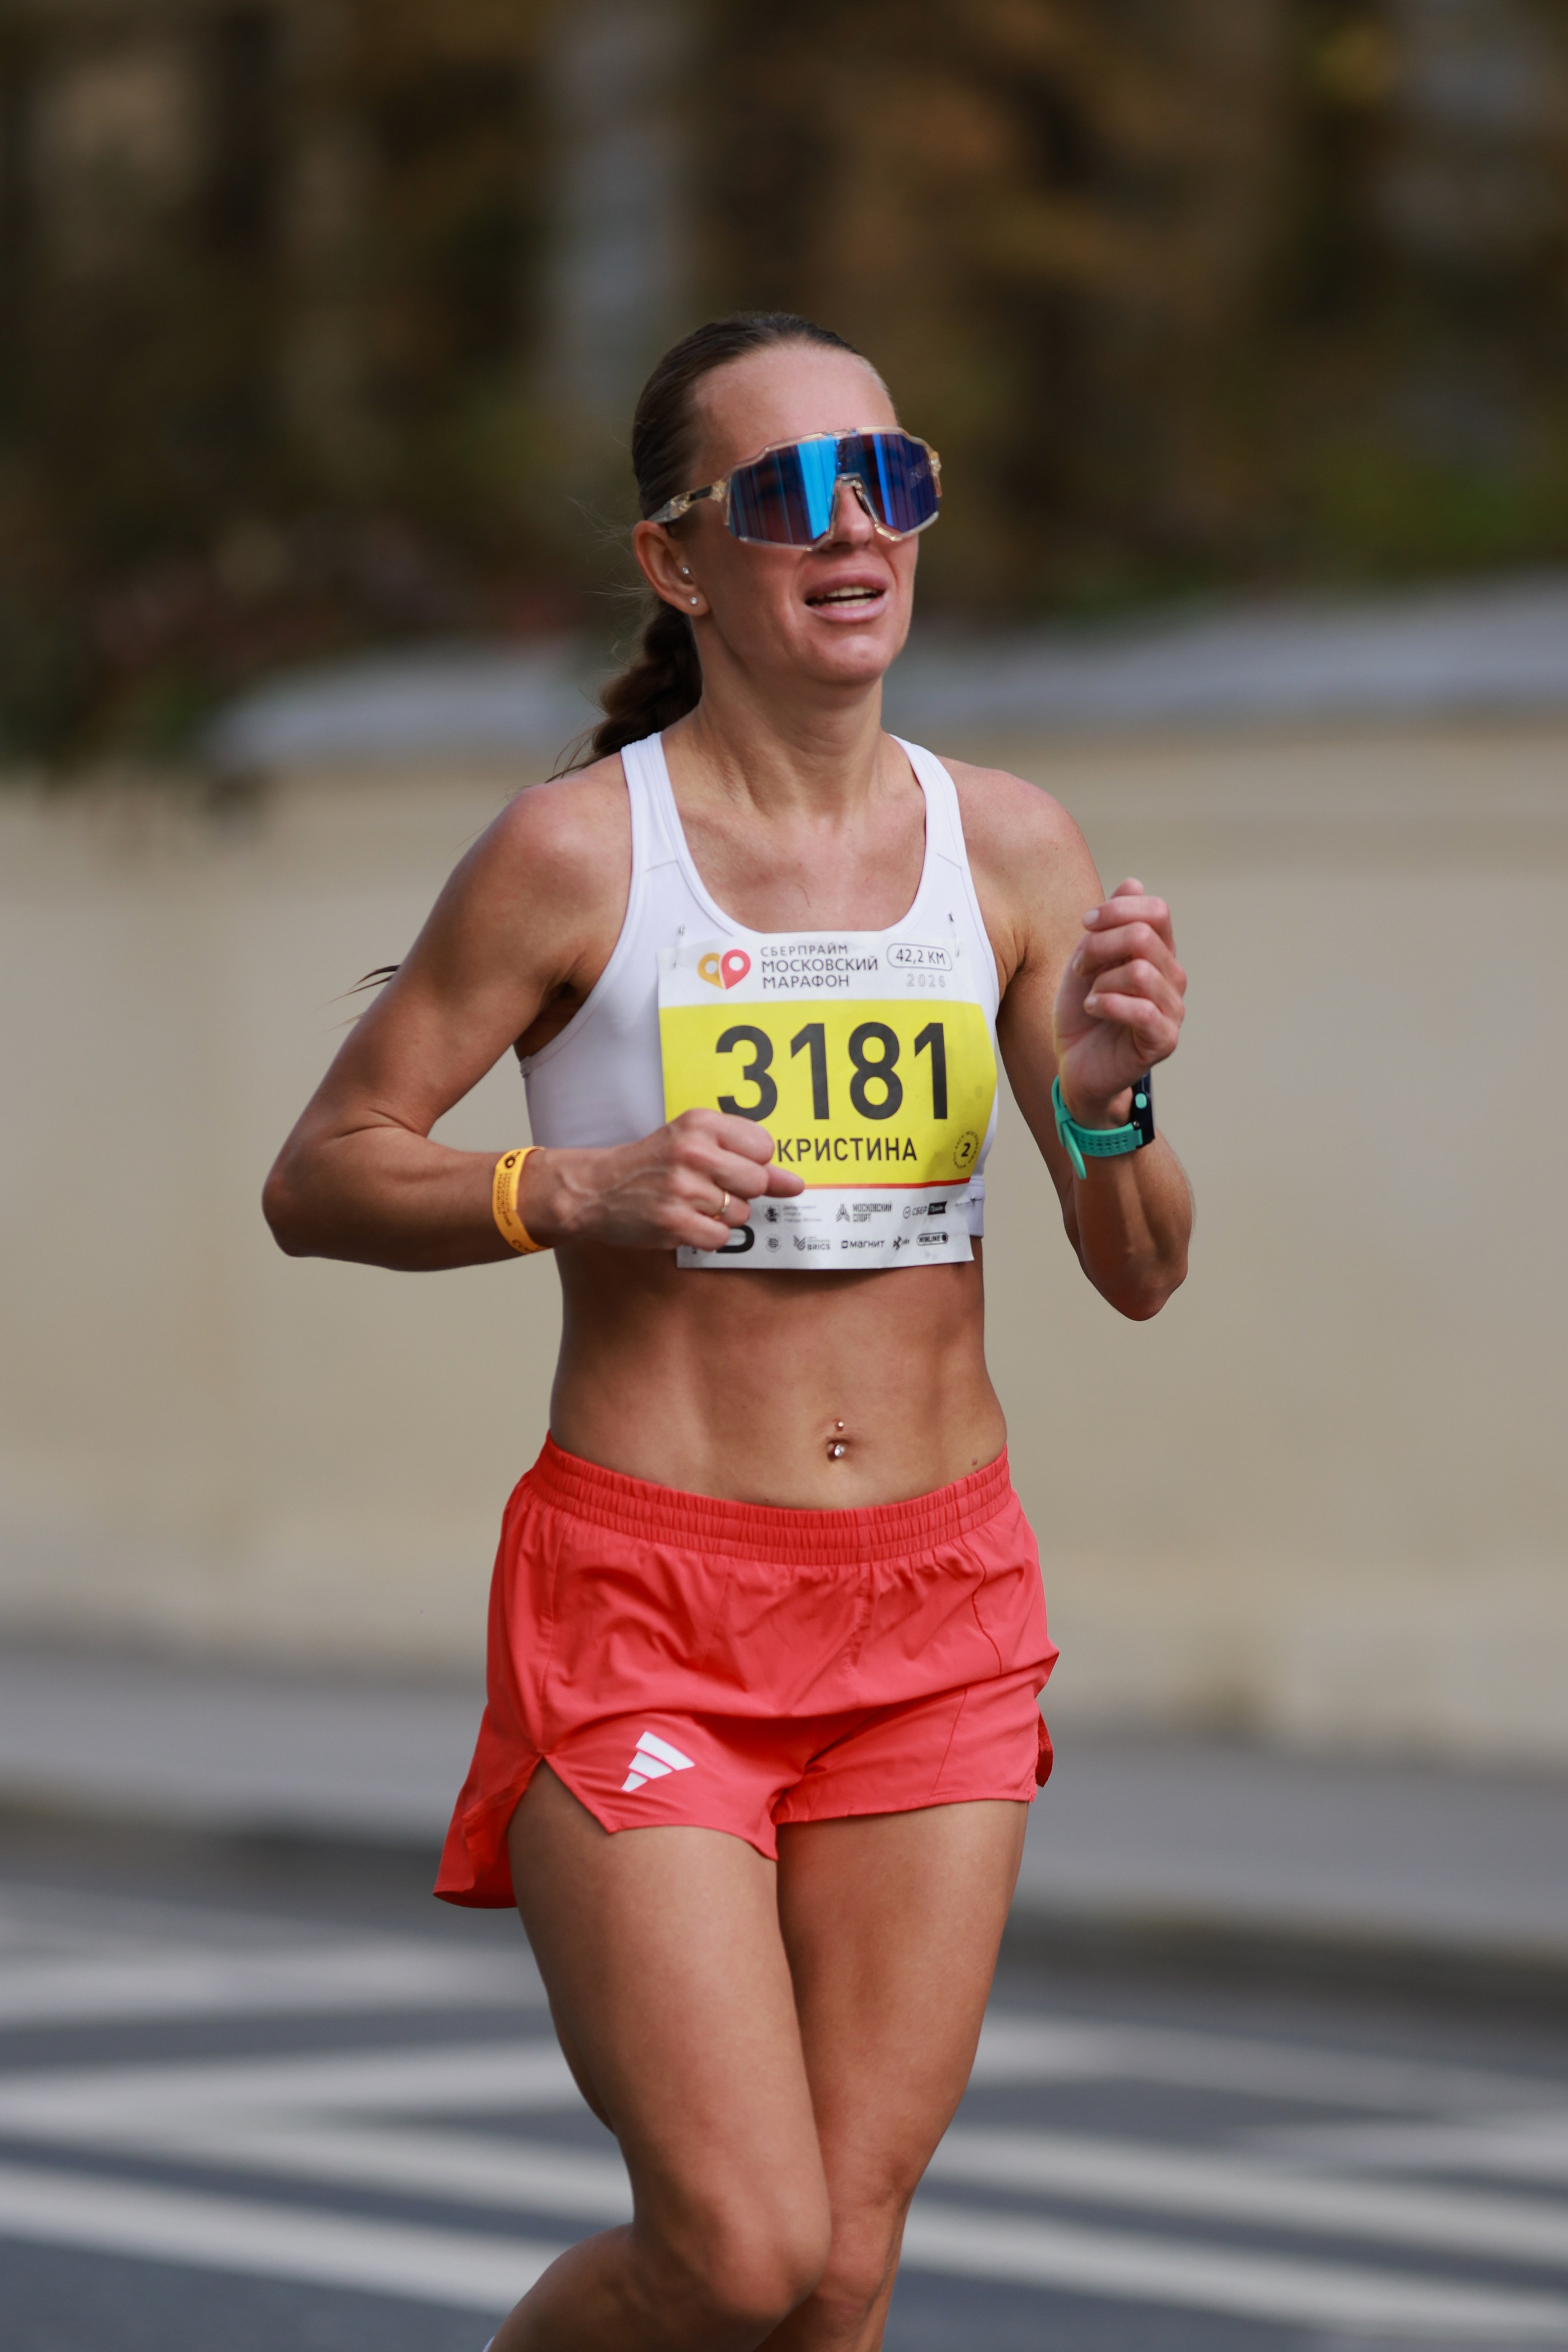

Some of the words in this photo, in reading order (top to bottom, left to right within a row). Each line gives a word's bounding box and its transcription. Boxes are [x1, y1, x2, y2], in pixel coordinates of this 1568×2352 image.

[760, 943, 848, 957] СБЕРПРАЙМ
[896, 949, 924, 964] 42,2
[761, 956, 878, 973] МОСКОВСКИЙ
[763, 974, 850, 989] МАРАФОН
[906, 973, 946, 988] 2026
[715, 1022, 948, 1122] 3181
[777, 1137, 918, 1163] КРИСТИНА
[961, 1142, 970, 1157] 2
[853, 1201, 892, 1212] МОСКОВСКИЙ
[853, 1213, 871, 1223] СПОРТ
